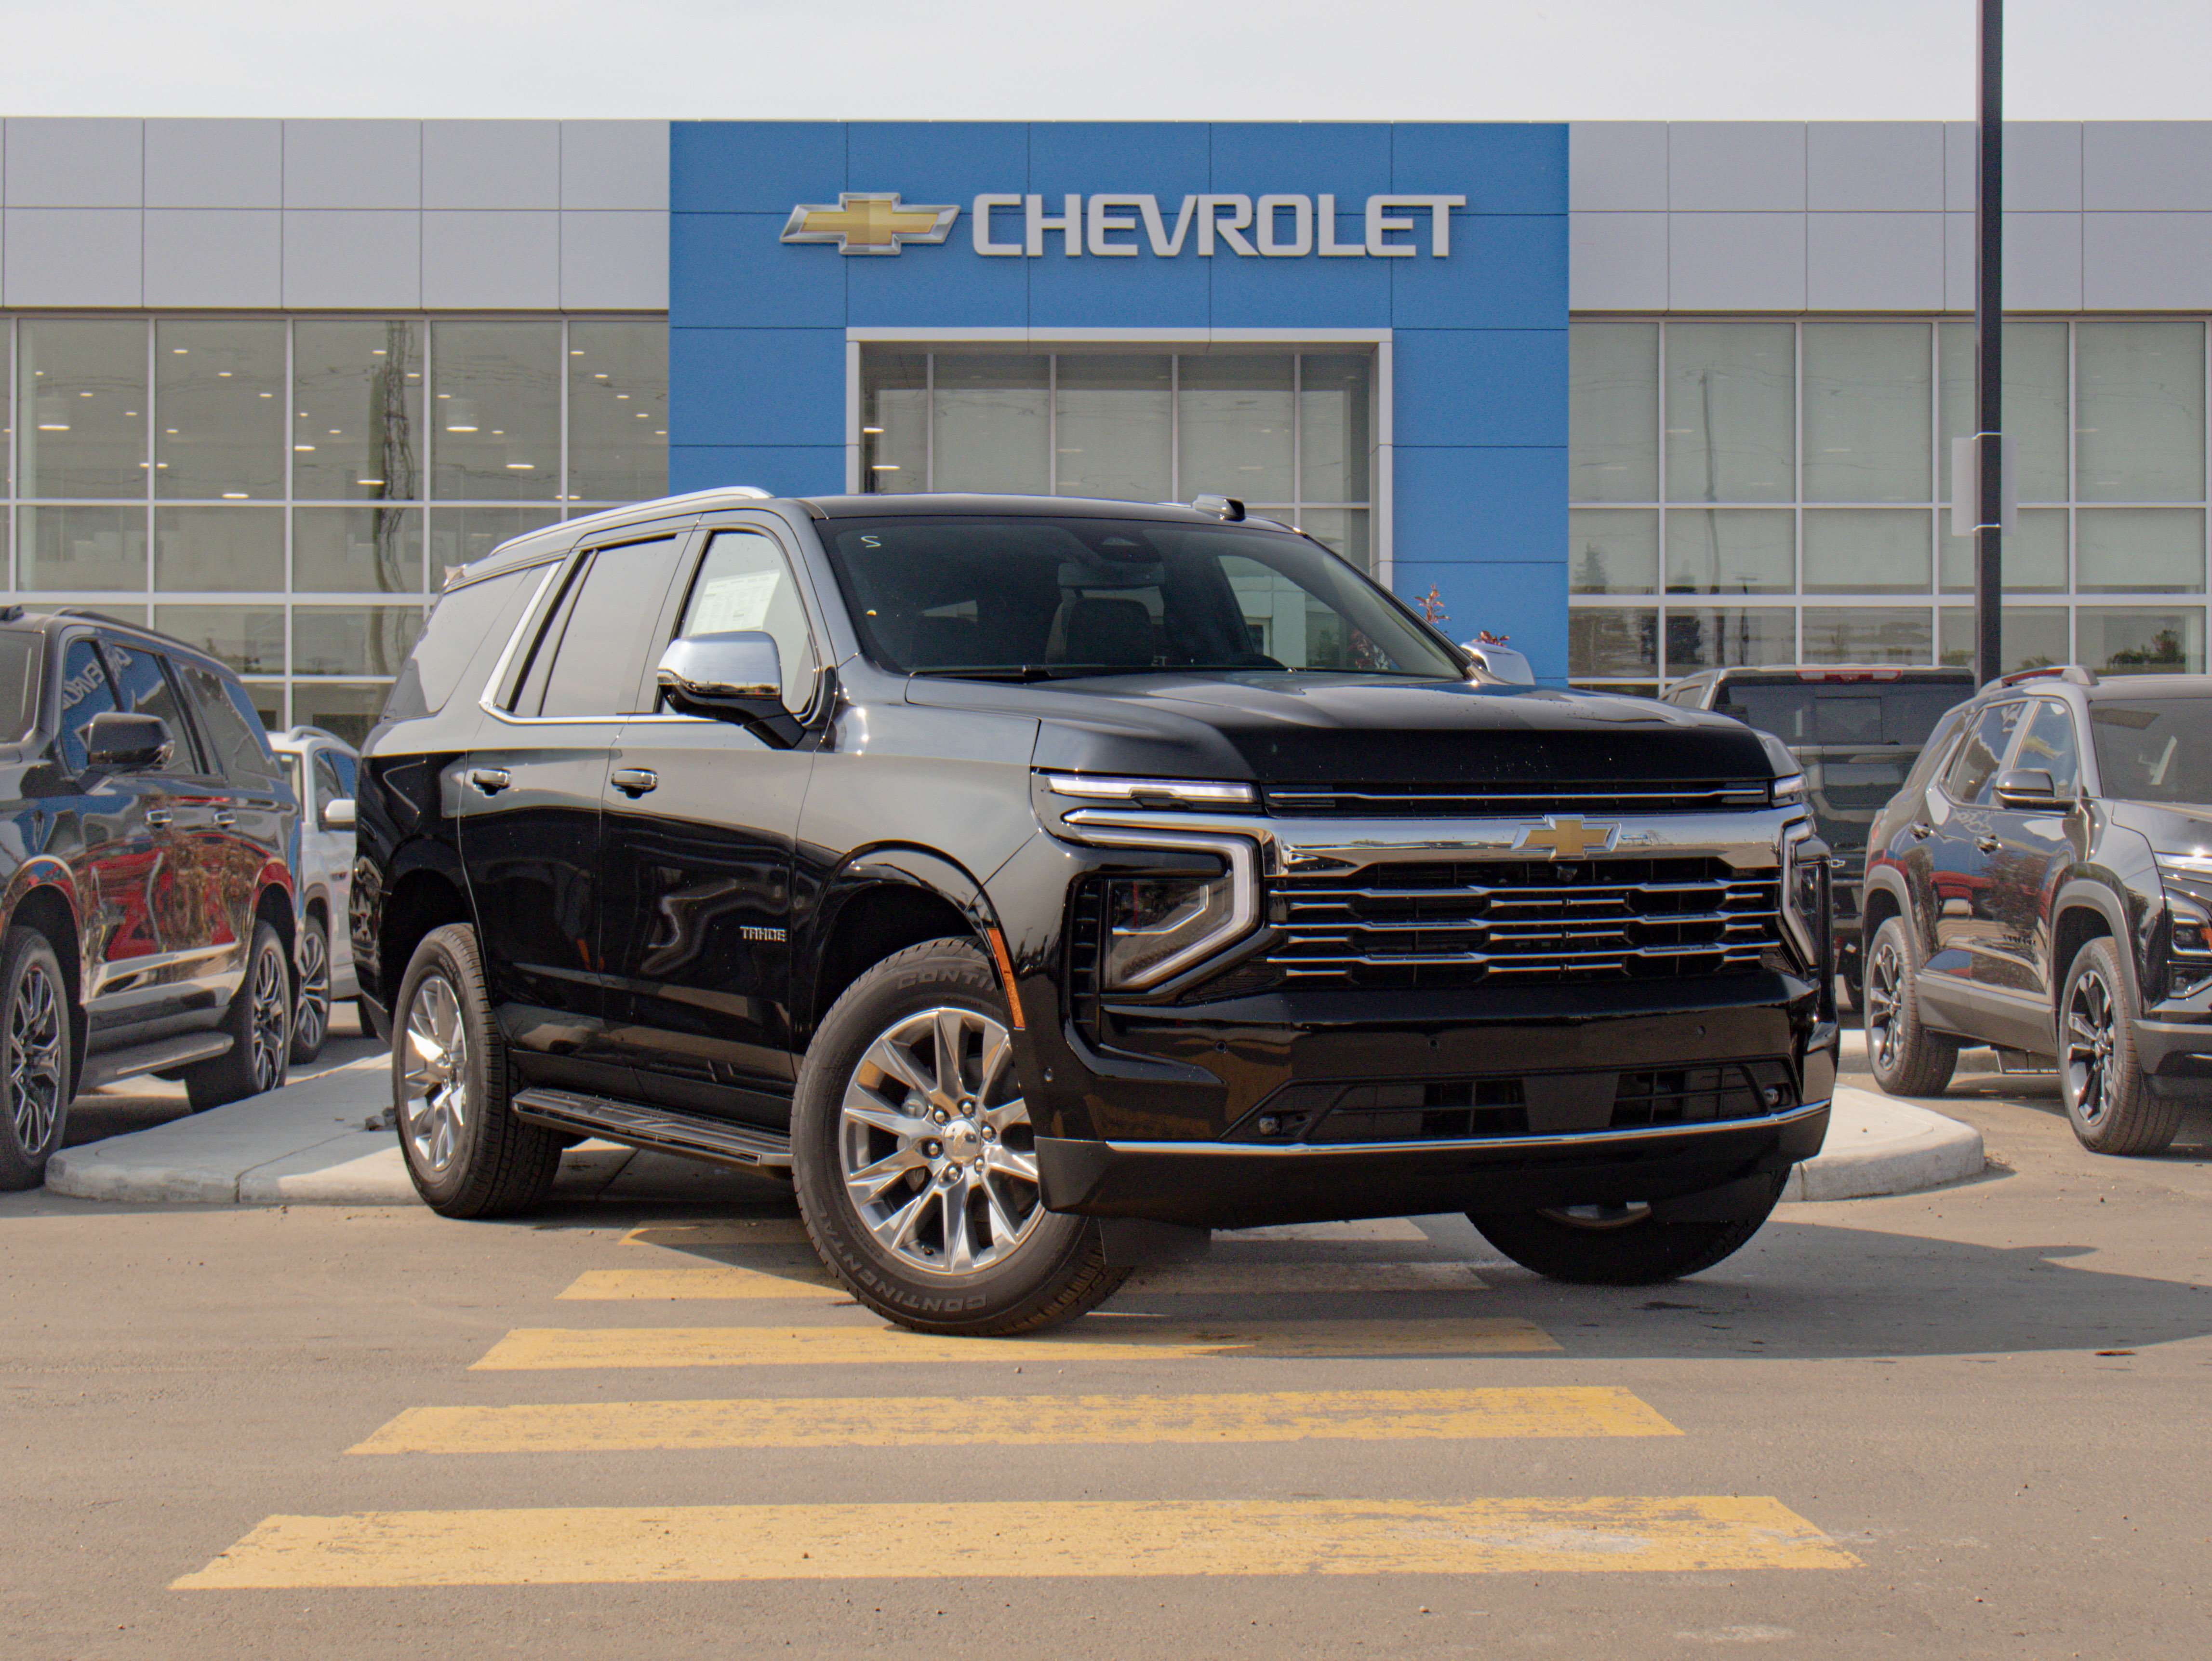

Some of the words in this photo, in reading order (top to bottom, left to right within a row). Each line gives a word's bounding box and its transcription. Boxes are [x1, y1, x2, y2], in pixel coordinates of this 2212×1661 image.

[973, 194, 1466, 256] CHEVROLET
[740, 925, 787, 942] TAHOE
[818, 1198, 987, 1312] CONTINENTAL
